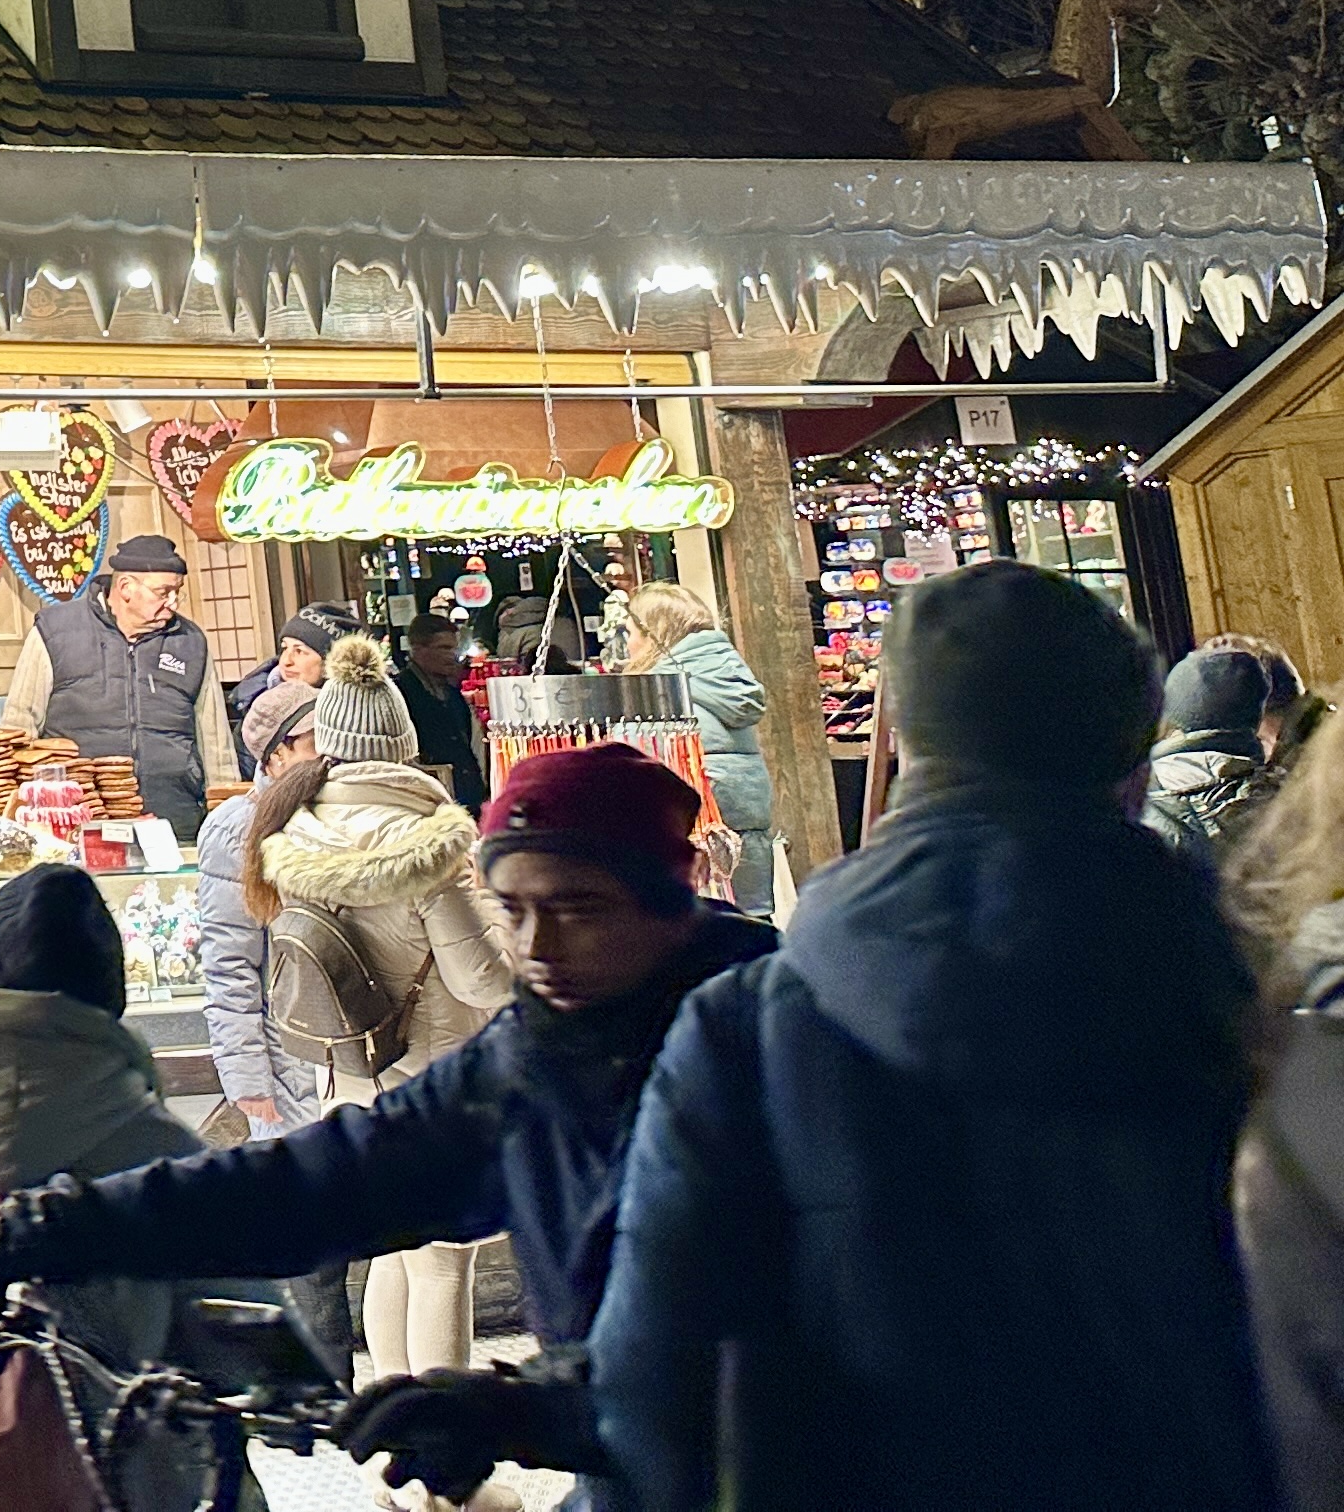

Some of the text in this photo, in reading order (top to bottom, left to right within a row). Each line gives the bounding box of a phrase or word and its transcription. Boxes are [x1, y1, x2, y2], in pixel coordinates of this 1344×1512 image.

[969, 410, 1000, 427] P17
[29, 469, 88, 496] hellster
[39, 486, 82, 507] Stern
[30, 520, 50, 539] ist
[24, 542, 74, 563] bei Dir
[44, 574, 77, 594] sein
[298, 607, 342, 638] Calvin
